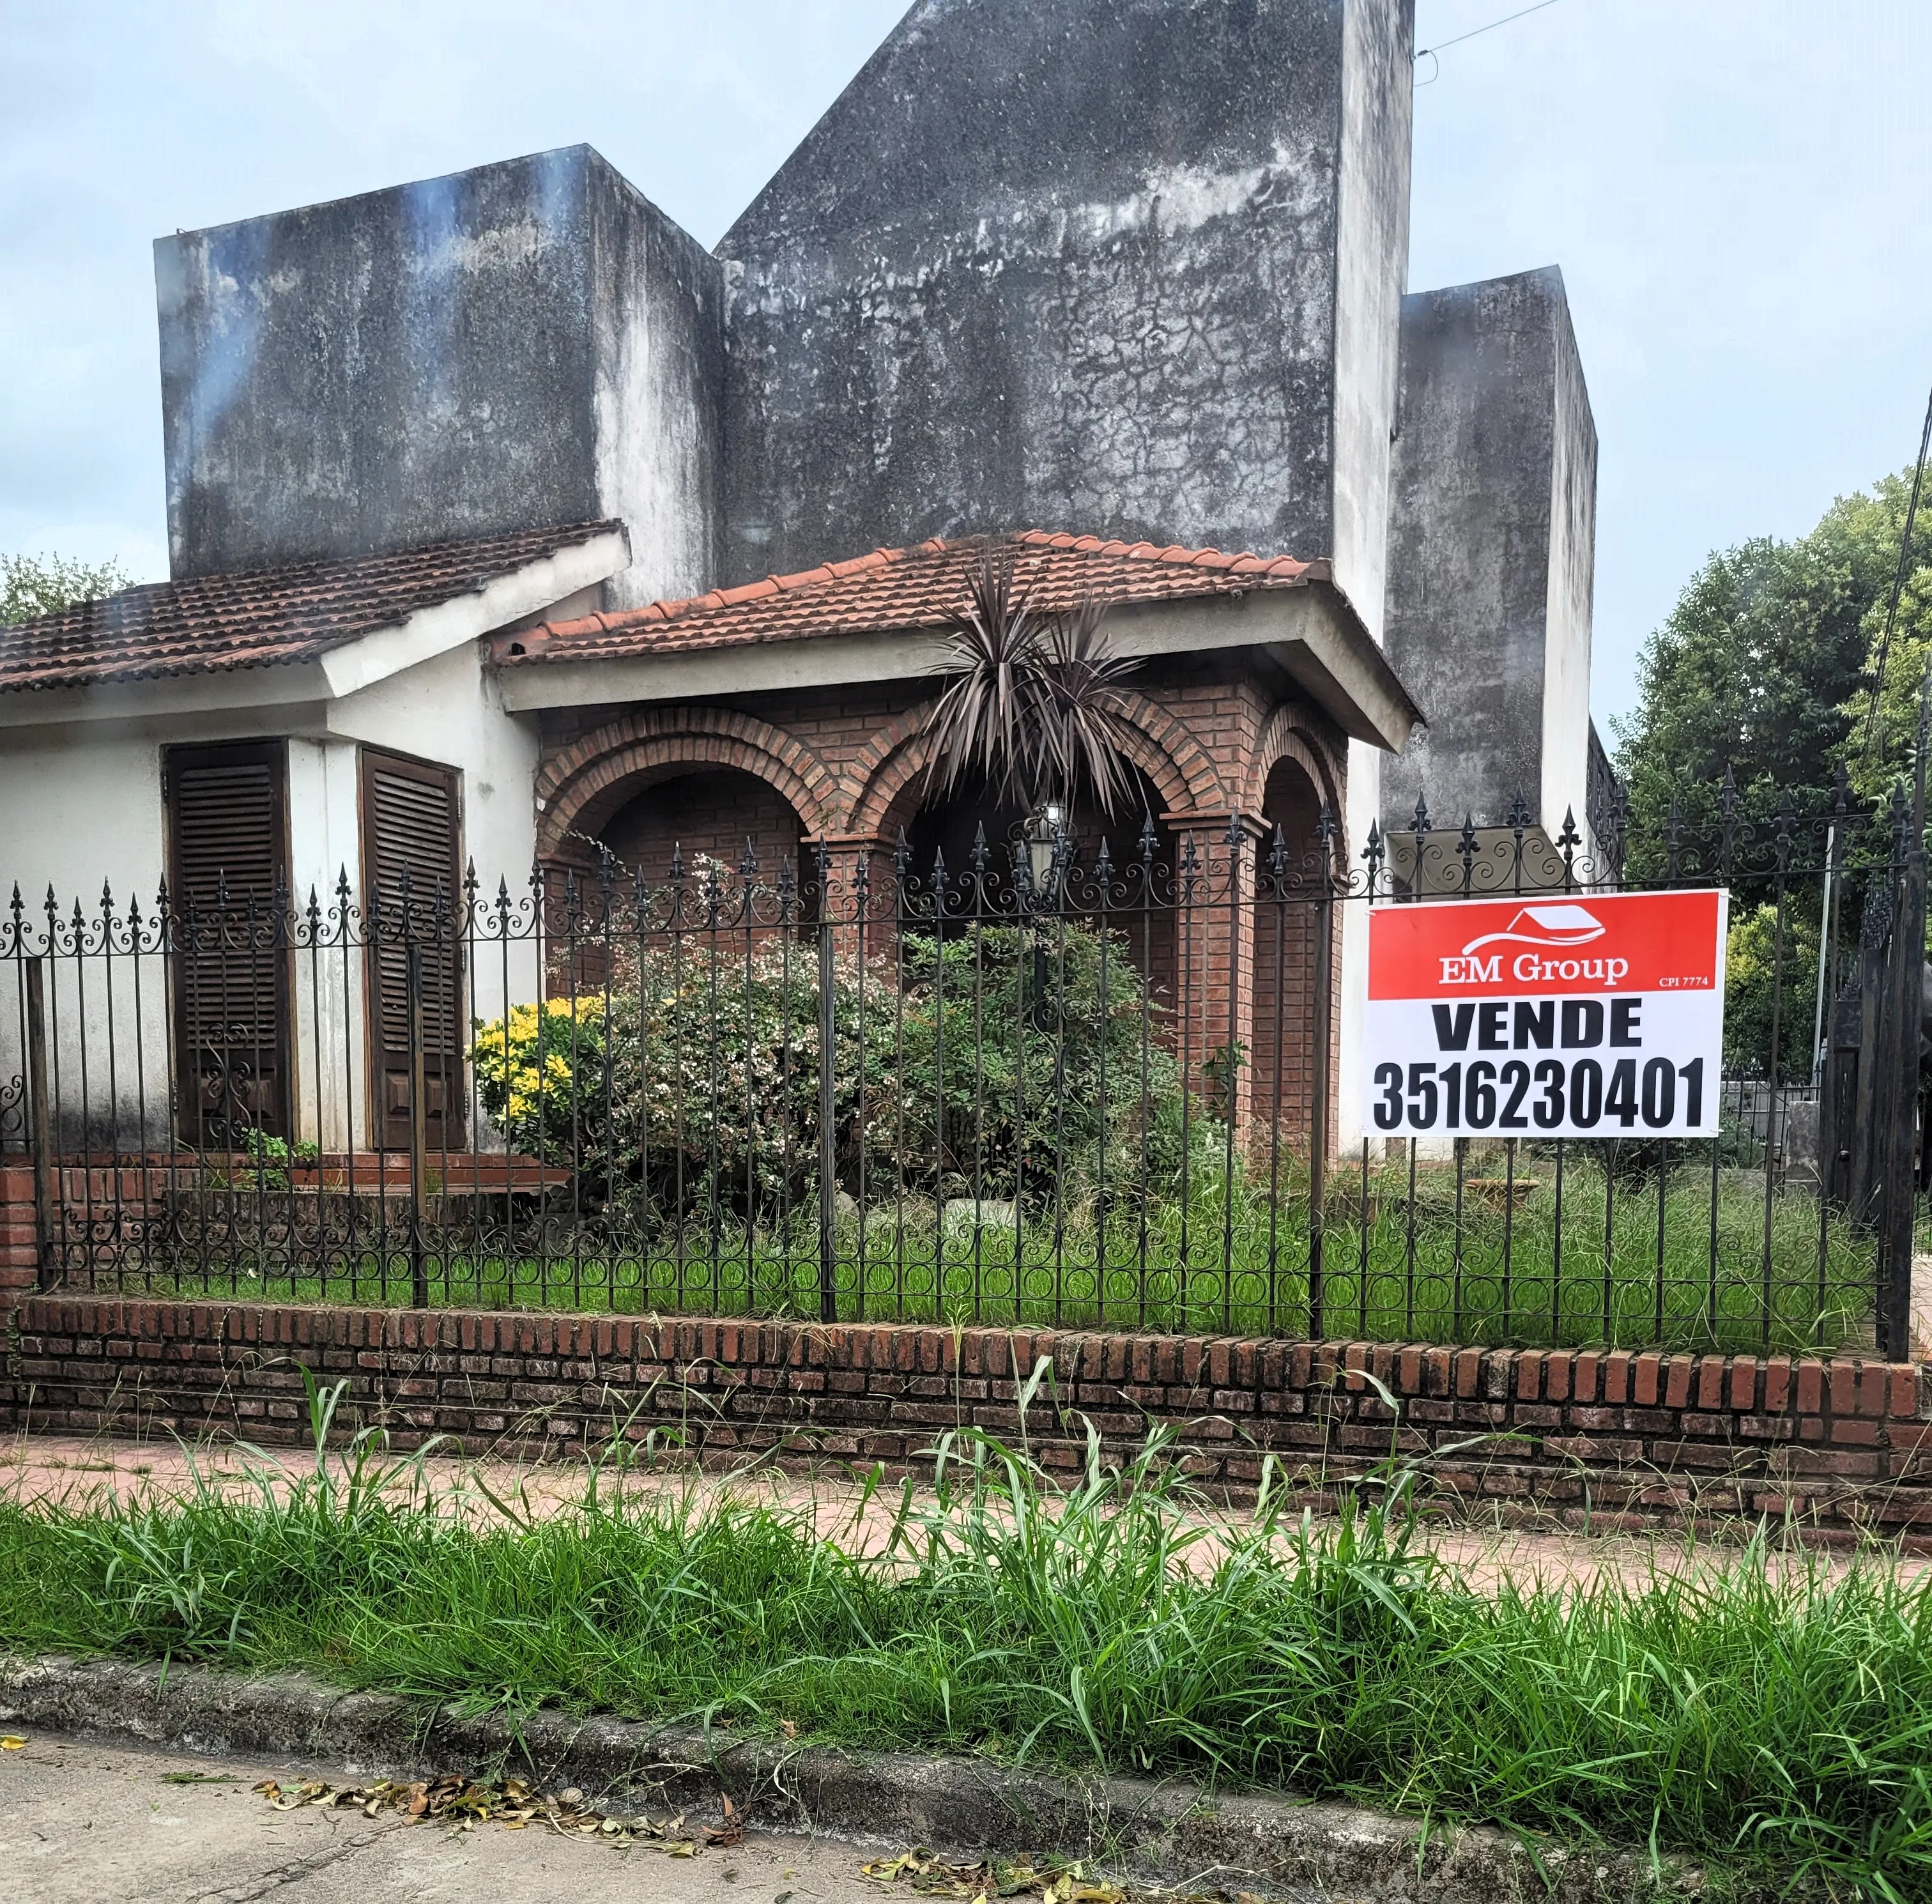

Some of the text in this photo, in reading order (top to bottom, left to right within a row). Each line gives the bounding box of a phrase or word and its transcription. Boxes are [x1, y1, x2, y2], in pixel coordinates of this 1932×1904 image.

[1438, 953, 1629, 985] EM Group
[1659, 976, 1708, 987] CPI 7774
[1431, 998, 1642, 1052] VENDE
[1374, 1057, 1704, 1130] 3516230401
